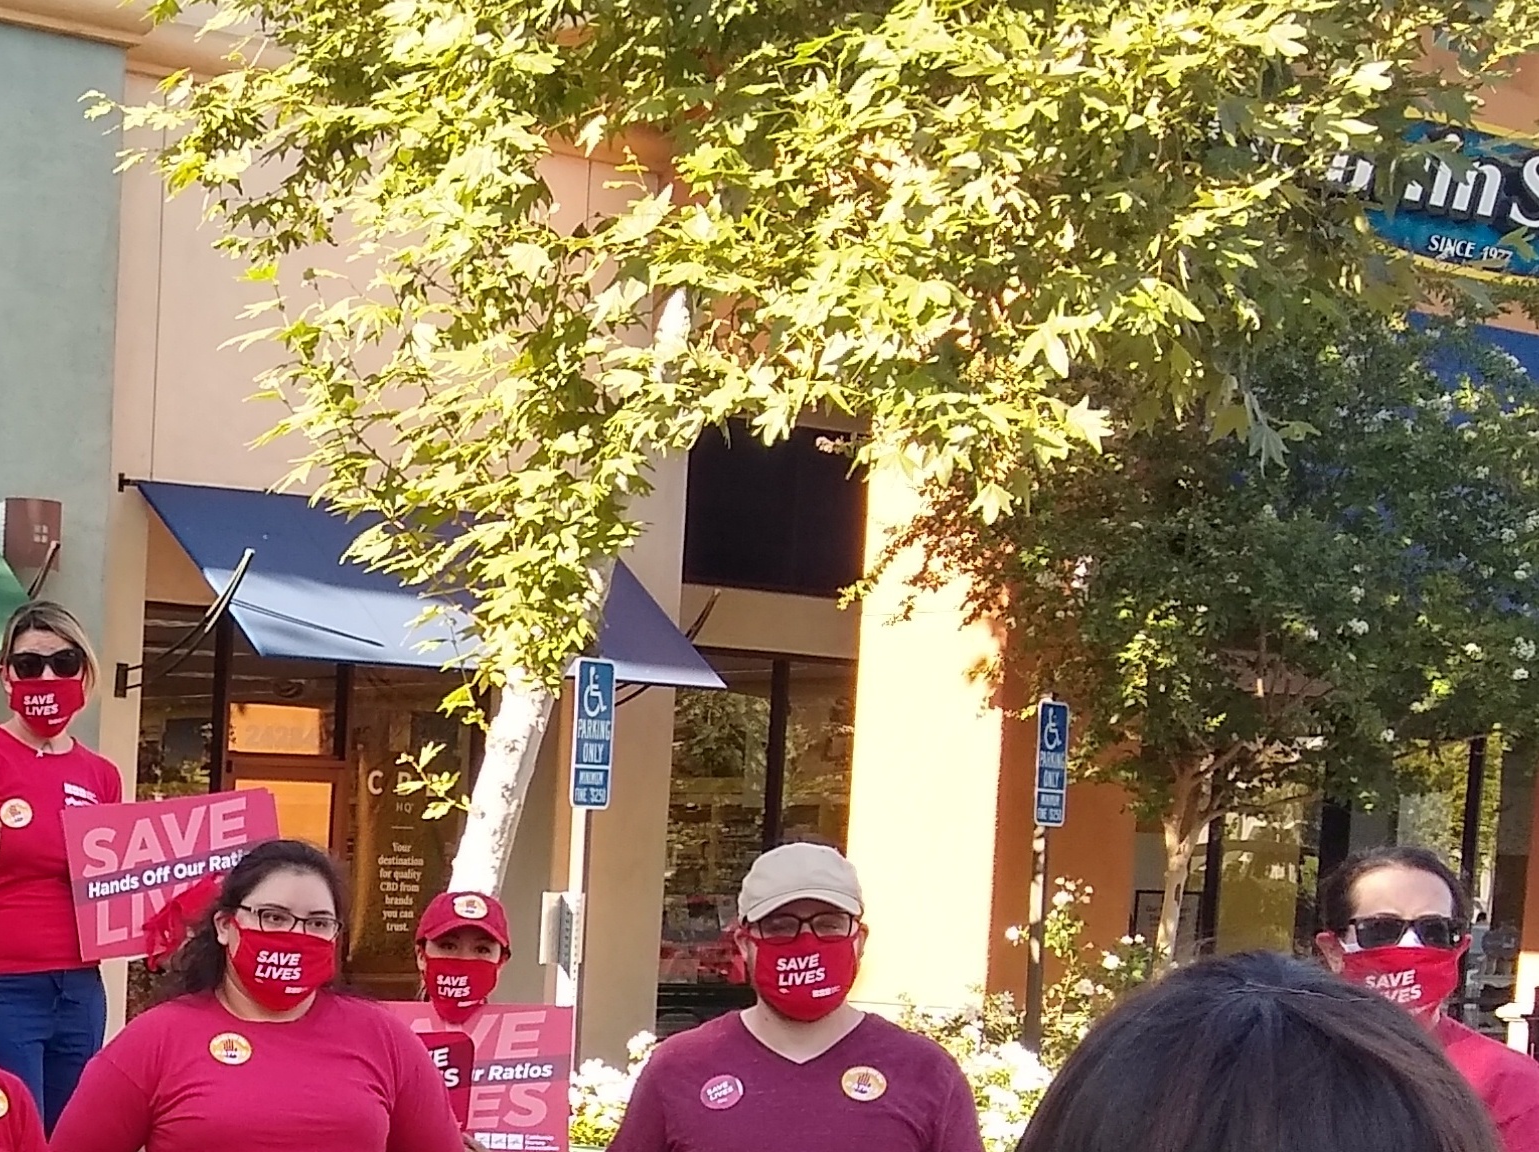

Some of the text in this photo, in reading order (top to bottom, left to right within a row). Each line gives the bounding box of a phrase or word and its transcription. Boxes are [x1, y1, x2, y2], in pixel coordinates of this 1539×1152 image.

[1428, 234, 1477, 259] SINCE
[23, 693, 56, 706] SAVE
[25, 703, 59, 716] LIVES
[577, 718, 612, 740] PARKING
[582, 742, 604, 763] ONLY
[82, 796, 247, 878] SAVE
[392, 841, 412, 853] Your
[377, 854, 425, 866] destination
[87, 847, 251, 899] Hands Off Our Rati
[379, 867, 422, 882] for quality
[379, 881, 420, 893] CBD from
[384, 894, 414, 906] brands
[382, 909, 414, 921] you can
[256, 950, 302, 966] SAVE
[775, 952, 820, 972] SAVE
[254, 964, 302, 980] LIVES
[778, 967, 826, 987] LIVES
[1364, 969, 1416, 990] SAVE
[436, 974, 469, 987] SAVE
[437, 986, 471, 998] LIVES
[1379, 983, 1422, 1003] VES
[488, 1062, 554, 1082] Ratios
